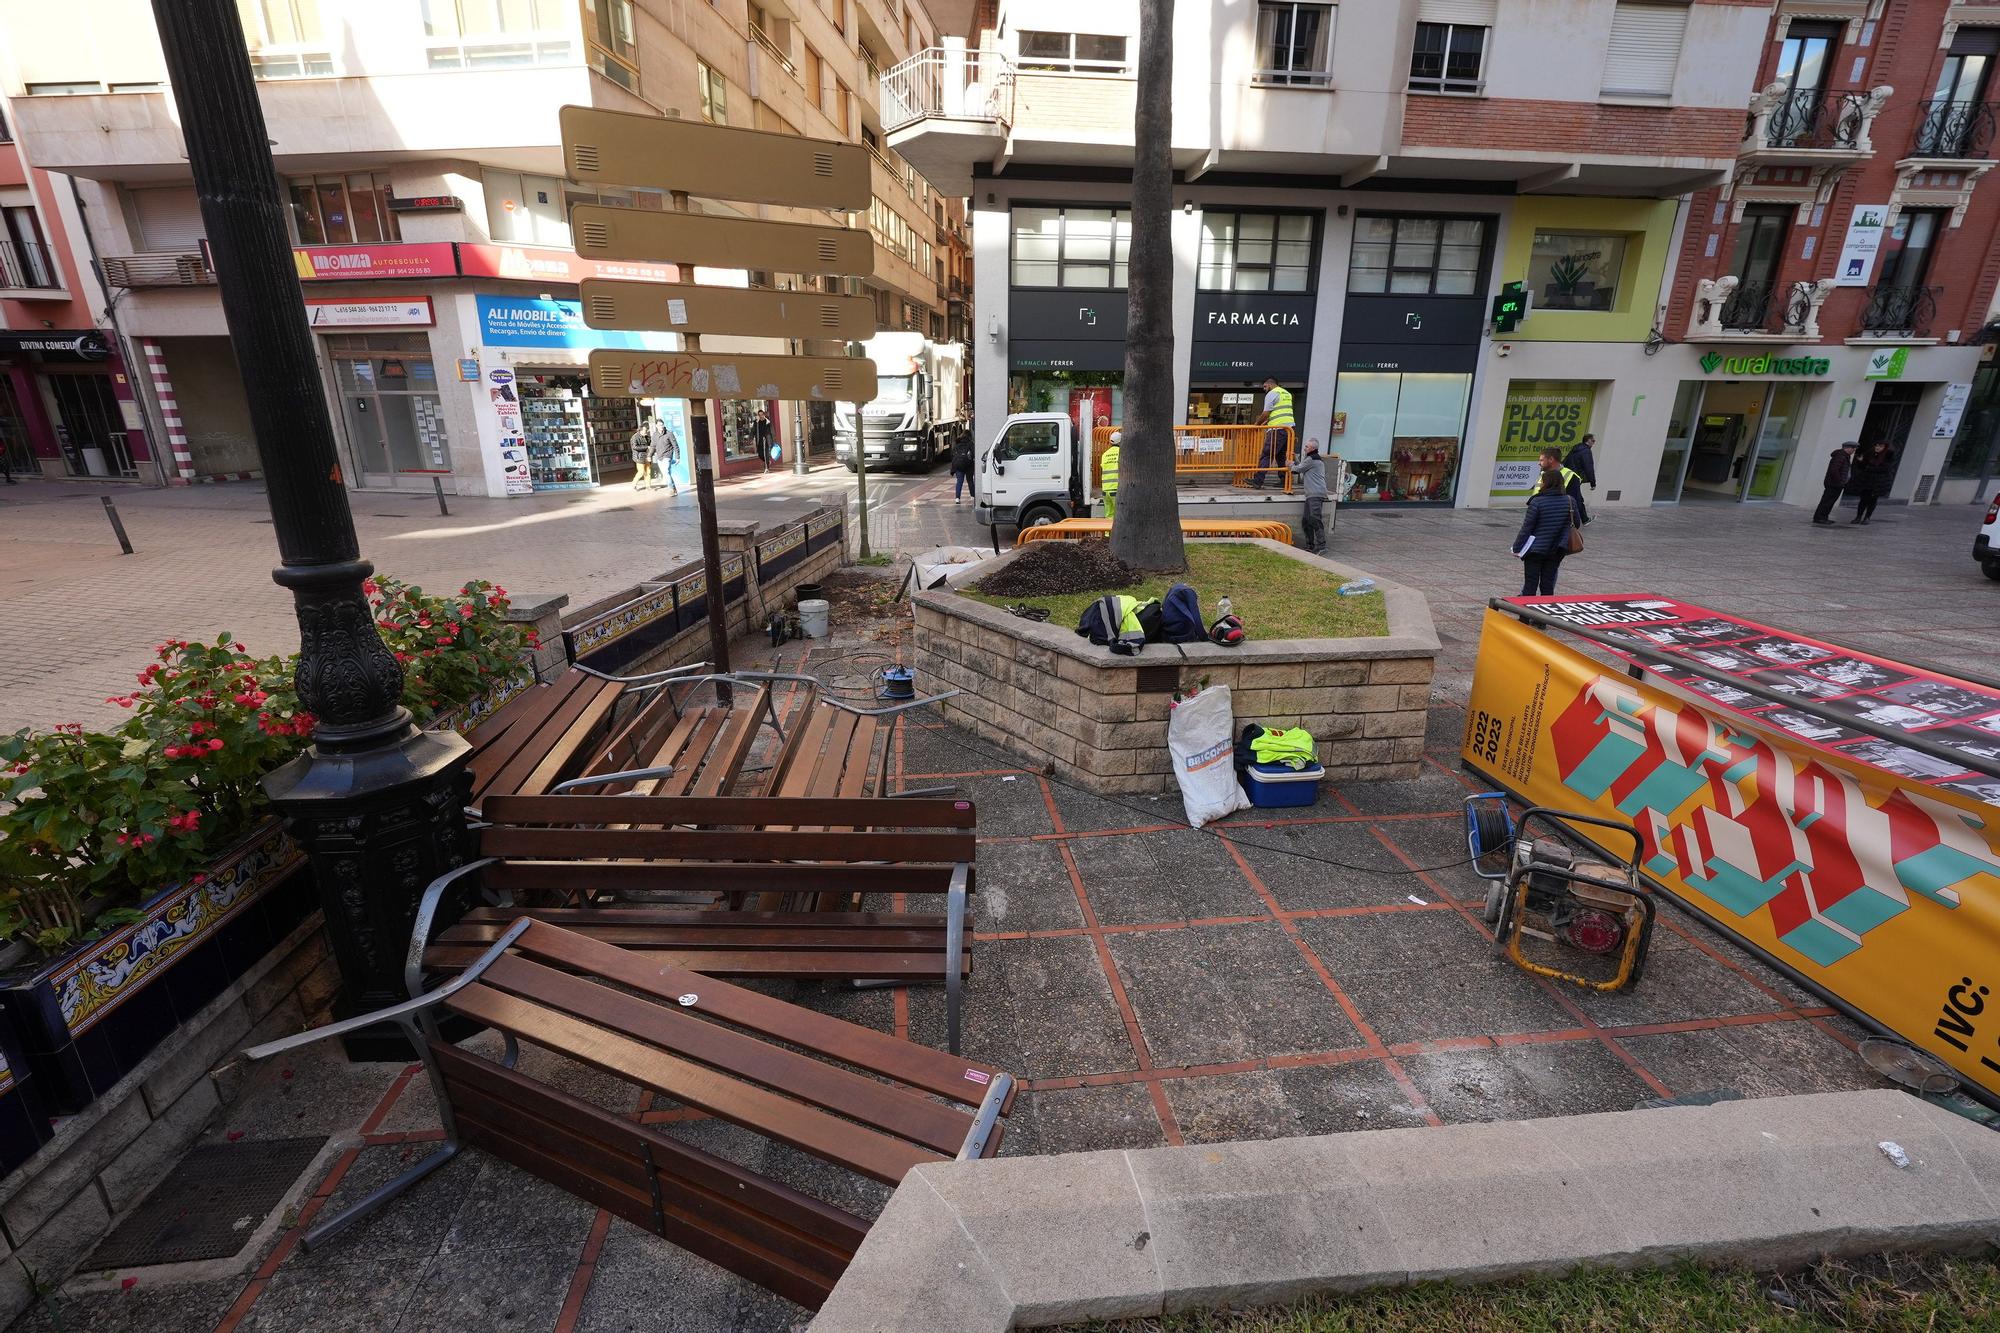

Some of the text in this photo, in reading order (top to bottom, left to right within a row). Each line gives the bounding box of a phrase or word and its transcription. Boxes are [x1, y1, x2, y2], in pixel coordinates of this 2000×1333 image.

[373, 258, 430, 266] AUTOESCUELA
[408, 267, 415, 275] 22
[488, 308, 507, 320] ALI
[511, 309, 557, 322] MOBILE
[517, 320, 541, 328] Móviles
[1208, 312, 1300, 326] FARMACIA
[20, 341, 44, 350] DIVINA
[1724, 351, 1830, 375] ruralnostra
[1518, 395, 1564, 403] Ruralnostra
[1565, 395, 1587, 403] tenim
[1500, 445, 1518, 453] Vine
[1518, 444, 1532, 454] pel
[1526, 601, 1620, 616] TEATRE
[1465, 710, 1476, 749] TEMPORADA
[1473, 710, 1489, 757] 2022
[1518, 752, 1527, 782] AUDITORI
[1524, 728, 1532, 749] PALAU
[1528, 683, 1541, 728] CONGRESSOS
[1485, 718, 1502, 765] 2023
[1512, 755, 1521, 778] MUSEU
[1518, 722, 1527, 747] BELLES
[1523, 764, 1532, 785] PALAU
[1529, 710, 1542, 755] CONGRESSOS
[1502, 748, 1510, 771] TEATRE
[1934, 976, 1990, 1053] IVC:
